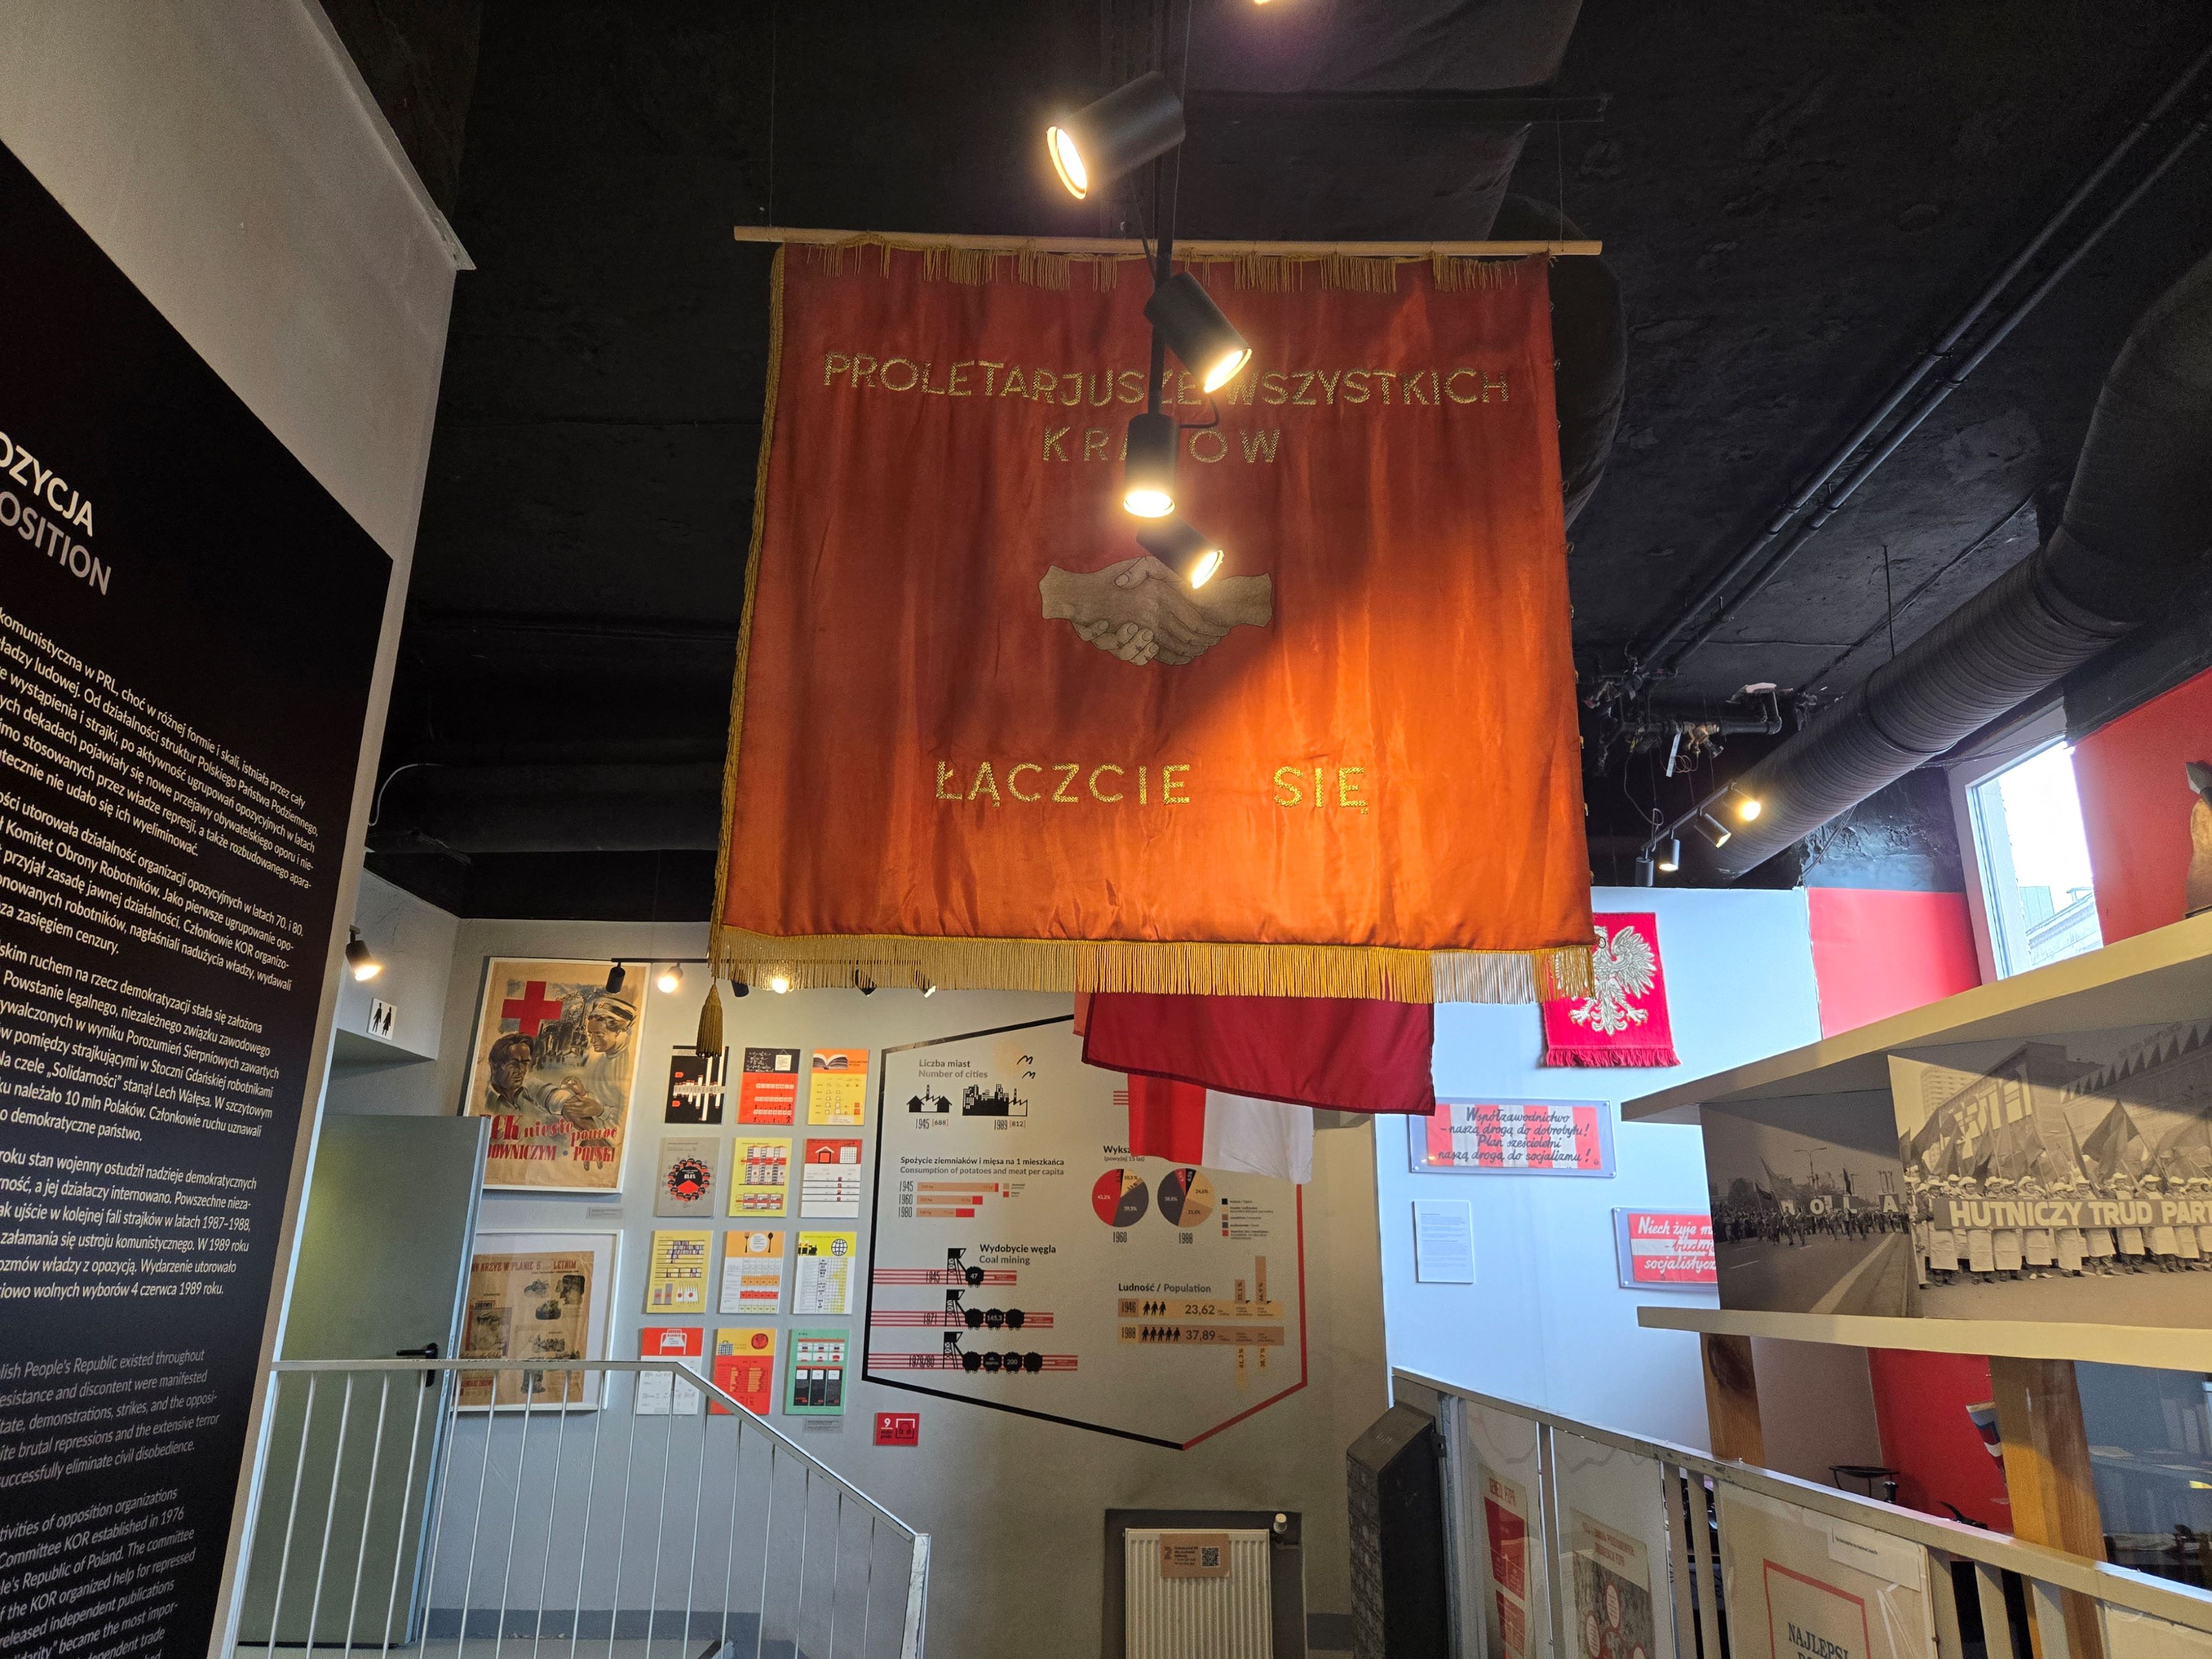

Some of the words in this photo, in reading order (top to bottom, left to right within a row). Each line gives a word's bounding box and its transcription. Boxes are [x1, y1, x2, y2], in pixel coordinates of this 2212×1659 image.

[1225, 367, 1509, 406] WSZYSTKICH
[0, 607, 82, 672] komunistyczna
[85, 665, 95, 678] w
[97, 670, 118, 696] PRL,
[122, 689, 145, 710] choć
[147, 705, 156, 716] w
[157, 712, 186, 737] różnej
[187, 727, 215, 753] formie
[216, 744, 220, 756] i
[221, 750, 240, 770] skali,
[242, 761, 269, 786] istniała
[270, 781, 289, 798] przez
[291, 794, 305, 809] cały
[935, 761, 1191, 808] ŁĄCZCIE
[1273, 766, 1369, 815] SIĘ
[4, 970, 63, 1000] Powstanie
[66, 988, 118, 1018] legalnego,
[121, 1006, 181, 1033] niezależnego
[183, 1025, 217, 1042] związku
[219, 1035, 270, 1057] zawodowego
[919, 1059, 946, 1067] Liczba
[948, 1059, 970, 1067] miast
[965, 1070, 988, 1078] cities
[14, 1083, 62, 1103] należało
[65, 1090, 80, 1106] 10
[82, 1095, 101, 1110] mln
[104, 1097, 145, 1118] Polaków.
[150, 1107, 200, 1127] Członkowie
[202, 1117, 226, 1131] ruchu
[228, 1124, 262, 1137] uznawali
[1466, 1107, 1570, 1125] Współzawodnictwo
[480, 1114, 523, 1139] CK
[524, 1119, 573, 1138] niesie
[571, 1127, 617, 1147] pomoc
[916, 1119, 930, 1129] 1945
[994, 1119, 1007, 1130] 1989
[1449, 1125, 1479, 1134] naszą
[1483, 1124, 1514, 1135] drogą
[1517, 1124, 1531, 1135] do
[1477, 1135, 1503, 1148] Plan
[573, 1146, 616, 1162] POLSKI
[1437, 1152, 1468, 1162] naszą
[1471, 1149, 1504, 1163] drogą
[1507, 1149, 1523, 1161] do
[901, 1157, 933, 1167] Spożycie
[983, 1158, 1004, 1166] mięsa
[28, 1153, 53, 1167] stan
[58, 1156, 103, 1176] wojenny
[104, 1162, 144, 1177] ostudził
[146, 1167, 183, 1184] nadzieje
[186, 1170, 257, 1191] demokratycznych
[900, 1167, 949, 1176] Consumption
[959, 1167, 992, 1176] potatoes
[899, 1181, 914, 1192] 1945
[899, 1194, 913, 1205] 1960
[899, 1206, 913, 1218] 1980
[1949, 1201, 2086, 1227] HUTNICZY
[2087, 1201, 2153, 1225] TRUD
[1638, 1217, 1670, 1234] Niech
[1113, 1232, 1127, 1243] 1960
[1179, 1232, 1193, 1244] 1988
[980, 1244, 1029, 1255] Wydobycie
[1031, 1245, 1056, 1255] węgla
[979, 1255, 998, 1263] Coal
[1000, 1256, 1030, 1265] mining
[34, 1282, 80, 1301] wolnych
[83, 1282, 130, 1299] wyborów
[131, 1282, 138, 1296] 4
[140, 1285, 177, 1296] czerwca
[179, 1282, 202, 1295] 1989
[204, 1282, 223, 1294] roku.
[1118, 1283, 1155, 1292] Ludność
[1164, 1284, 1211, 1292] Population
[1185, 1304, 1215, 1316] 23,62
[1186, 1330, 1215, 1341] 37,89
[24, 1359, 71, 1378] People's
[73, 1355, 118, 1374] Republic
[120, 1352, 154, 1368] existed
[156, 1350, 205, 1365] throughout
[884, 1418, 890, 1427] 9
[64, 1531, 90, 1551] KOR
[92, 1516, 148, 1543] established
[149, 1514, 158, 1528] in
[161, 1507, 184, 1524] 1976
[8, 1603, 27, 1620] the
[30, 1591, 57, 1613] KOR
[59, 1573, 111, 1603] organized
[112, 1568, 134, 1586] help
[137, 1564, 151, 1578] for
[152, 1547, 196, 1573] repressed
